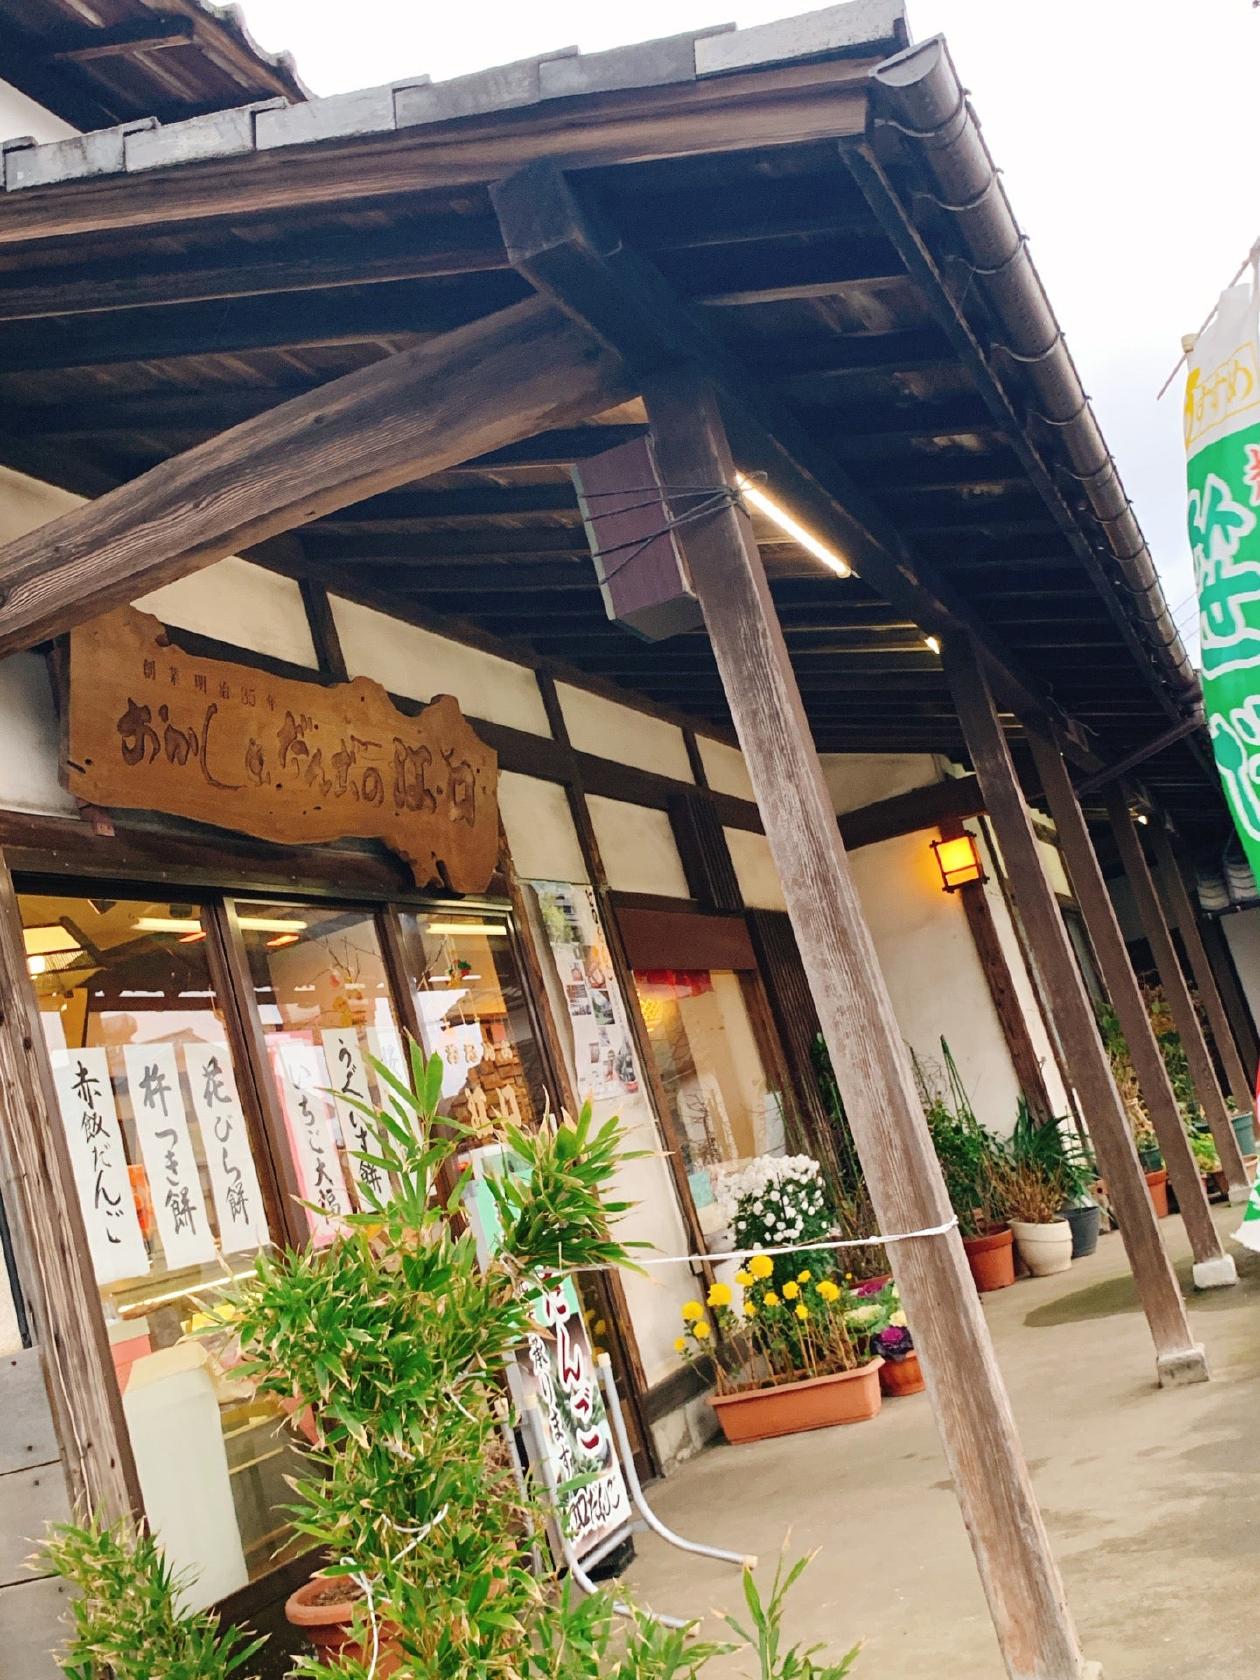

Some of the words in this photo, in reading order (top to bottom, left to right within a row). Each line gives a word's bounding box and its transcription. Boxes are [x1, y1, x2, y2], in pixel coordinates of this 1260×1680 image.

[143, 658, 278, 712] 創業明治35年
[71, 1059, 122, 1244] 赤飯だんご
[138, 1062, 198, 1237] 杵つき餅
[201, 1055, 251, 1226] 花びら餅
[287, 1061, 342, 1226] いちご大福
